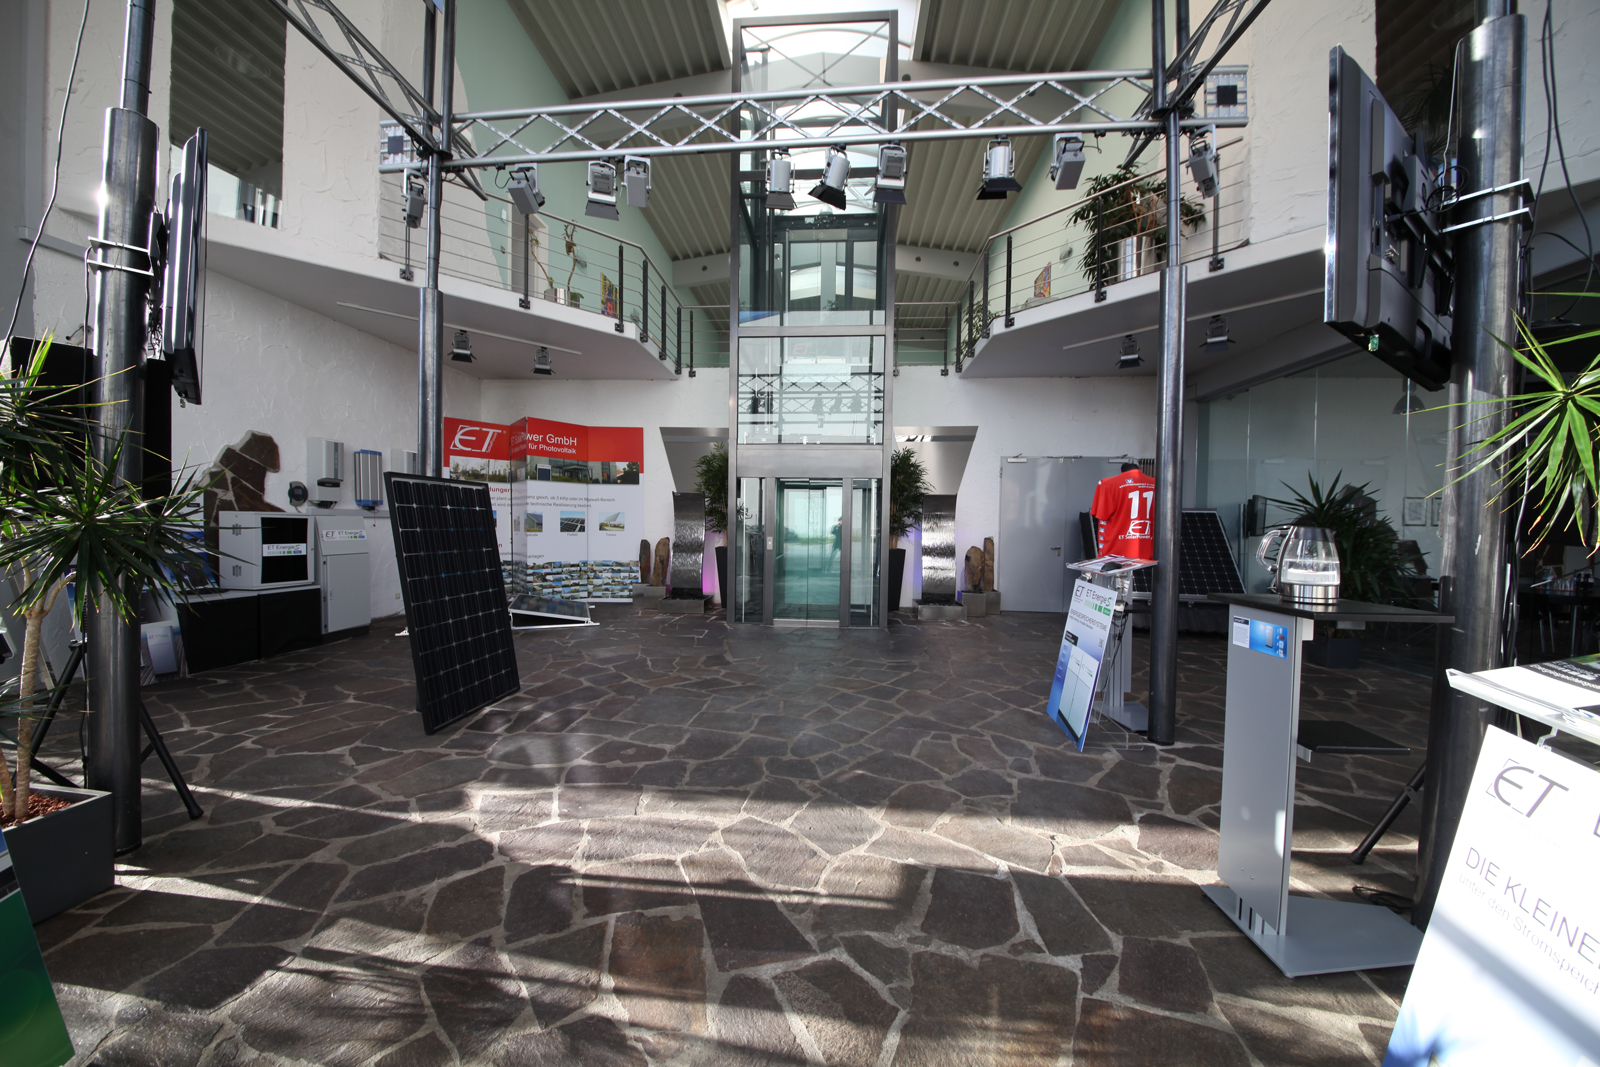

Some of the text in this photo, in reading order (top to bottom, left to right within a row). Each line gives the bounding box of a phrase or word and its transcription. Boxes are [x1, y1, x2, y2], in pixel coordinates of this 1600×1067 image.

[452, 427, 502, 452] ET
[539, 444, 577, 454] Photovoltaik
[546, 434, 577, 446] GmbH
[1128, 490, 1153, 519] 11
[1493, 765, 1569, 818] ET
[1459, 873, 1486, 900] unter
[1488, 896, 1510, 921] den
[1465, 846, 1600, 971] DIE KLEINE
